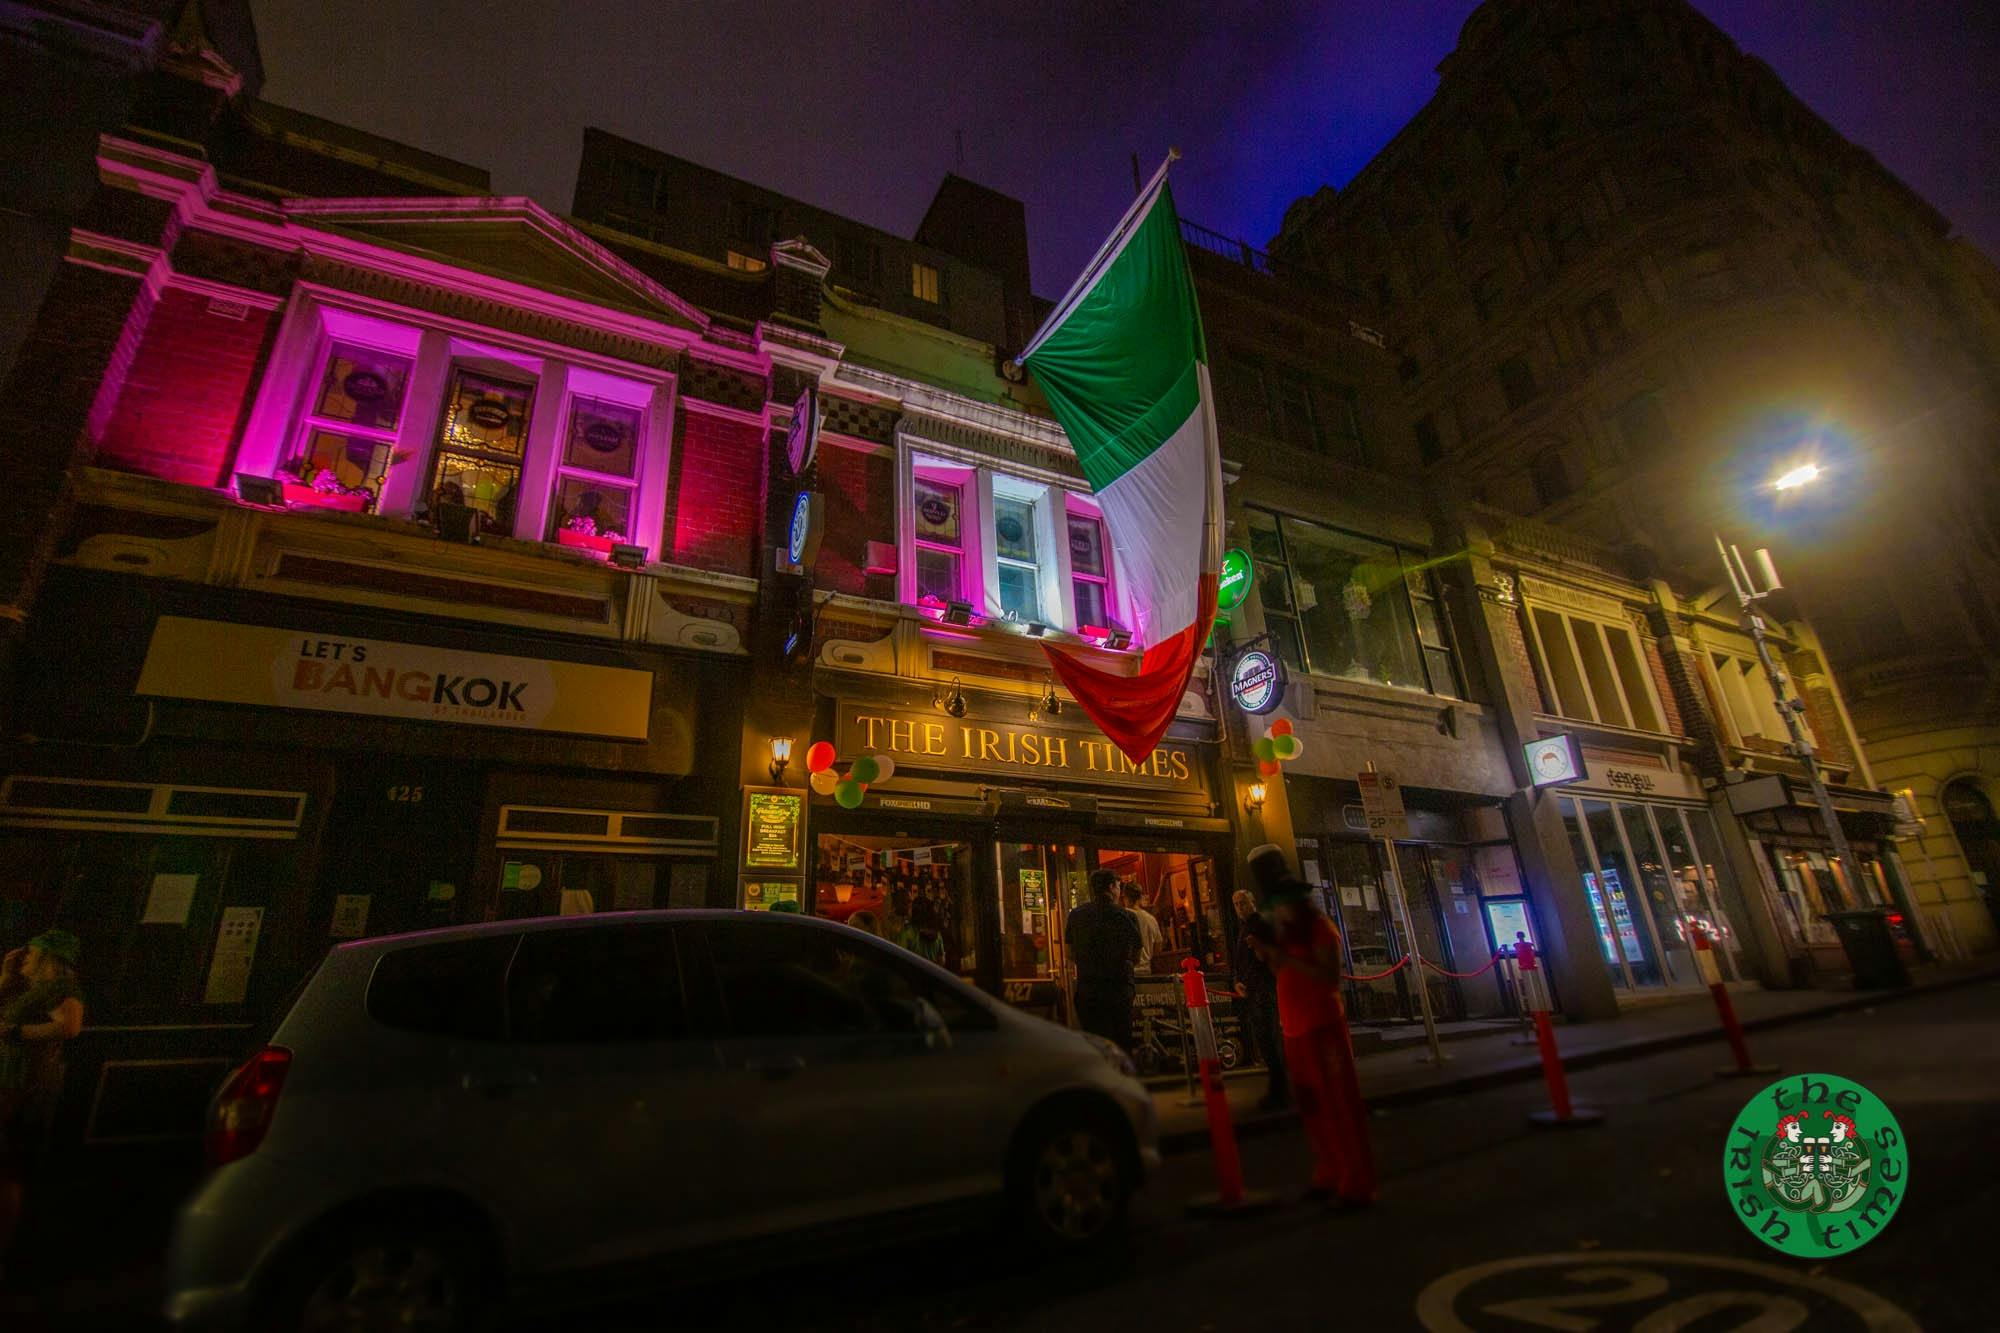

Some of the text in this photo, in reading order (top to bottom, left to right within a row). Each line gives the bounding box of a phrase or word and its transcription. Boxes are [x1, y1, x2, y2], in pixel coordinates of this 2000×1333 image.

[301, 639, 367, 662] LET'S
[293, 659, 528, 712] BANGKOK
[1233, 668, 1273, 695] MAGNERS
[857, 716, 1189, 781] THE IRISH TIMES
[1606, 768, 1655, 794] tengu
[1368, 817, 1386, 829] 2P
